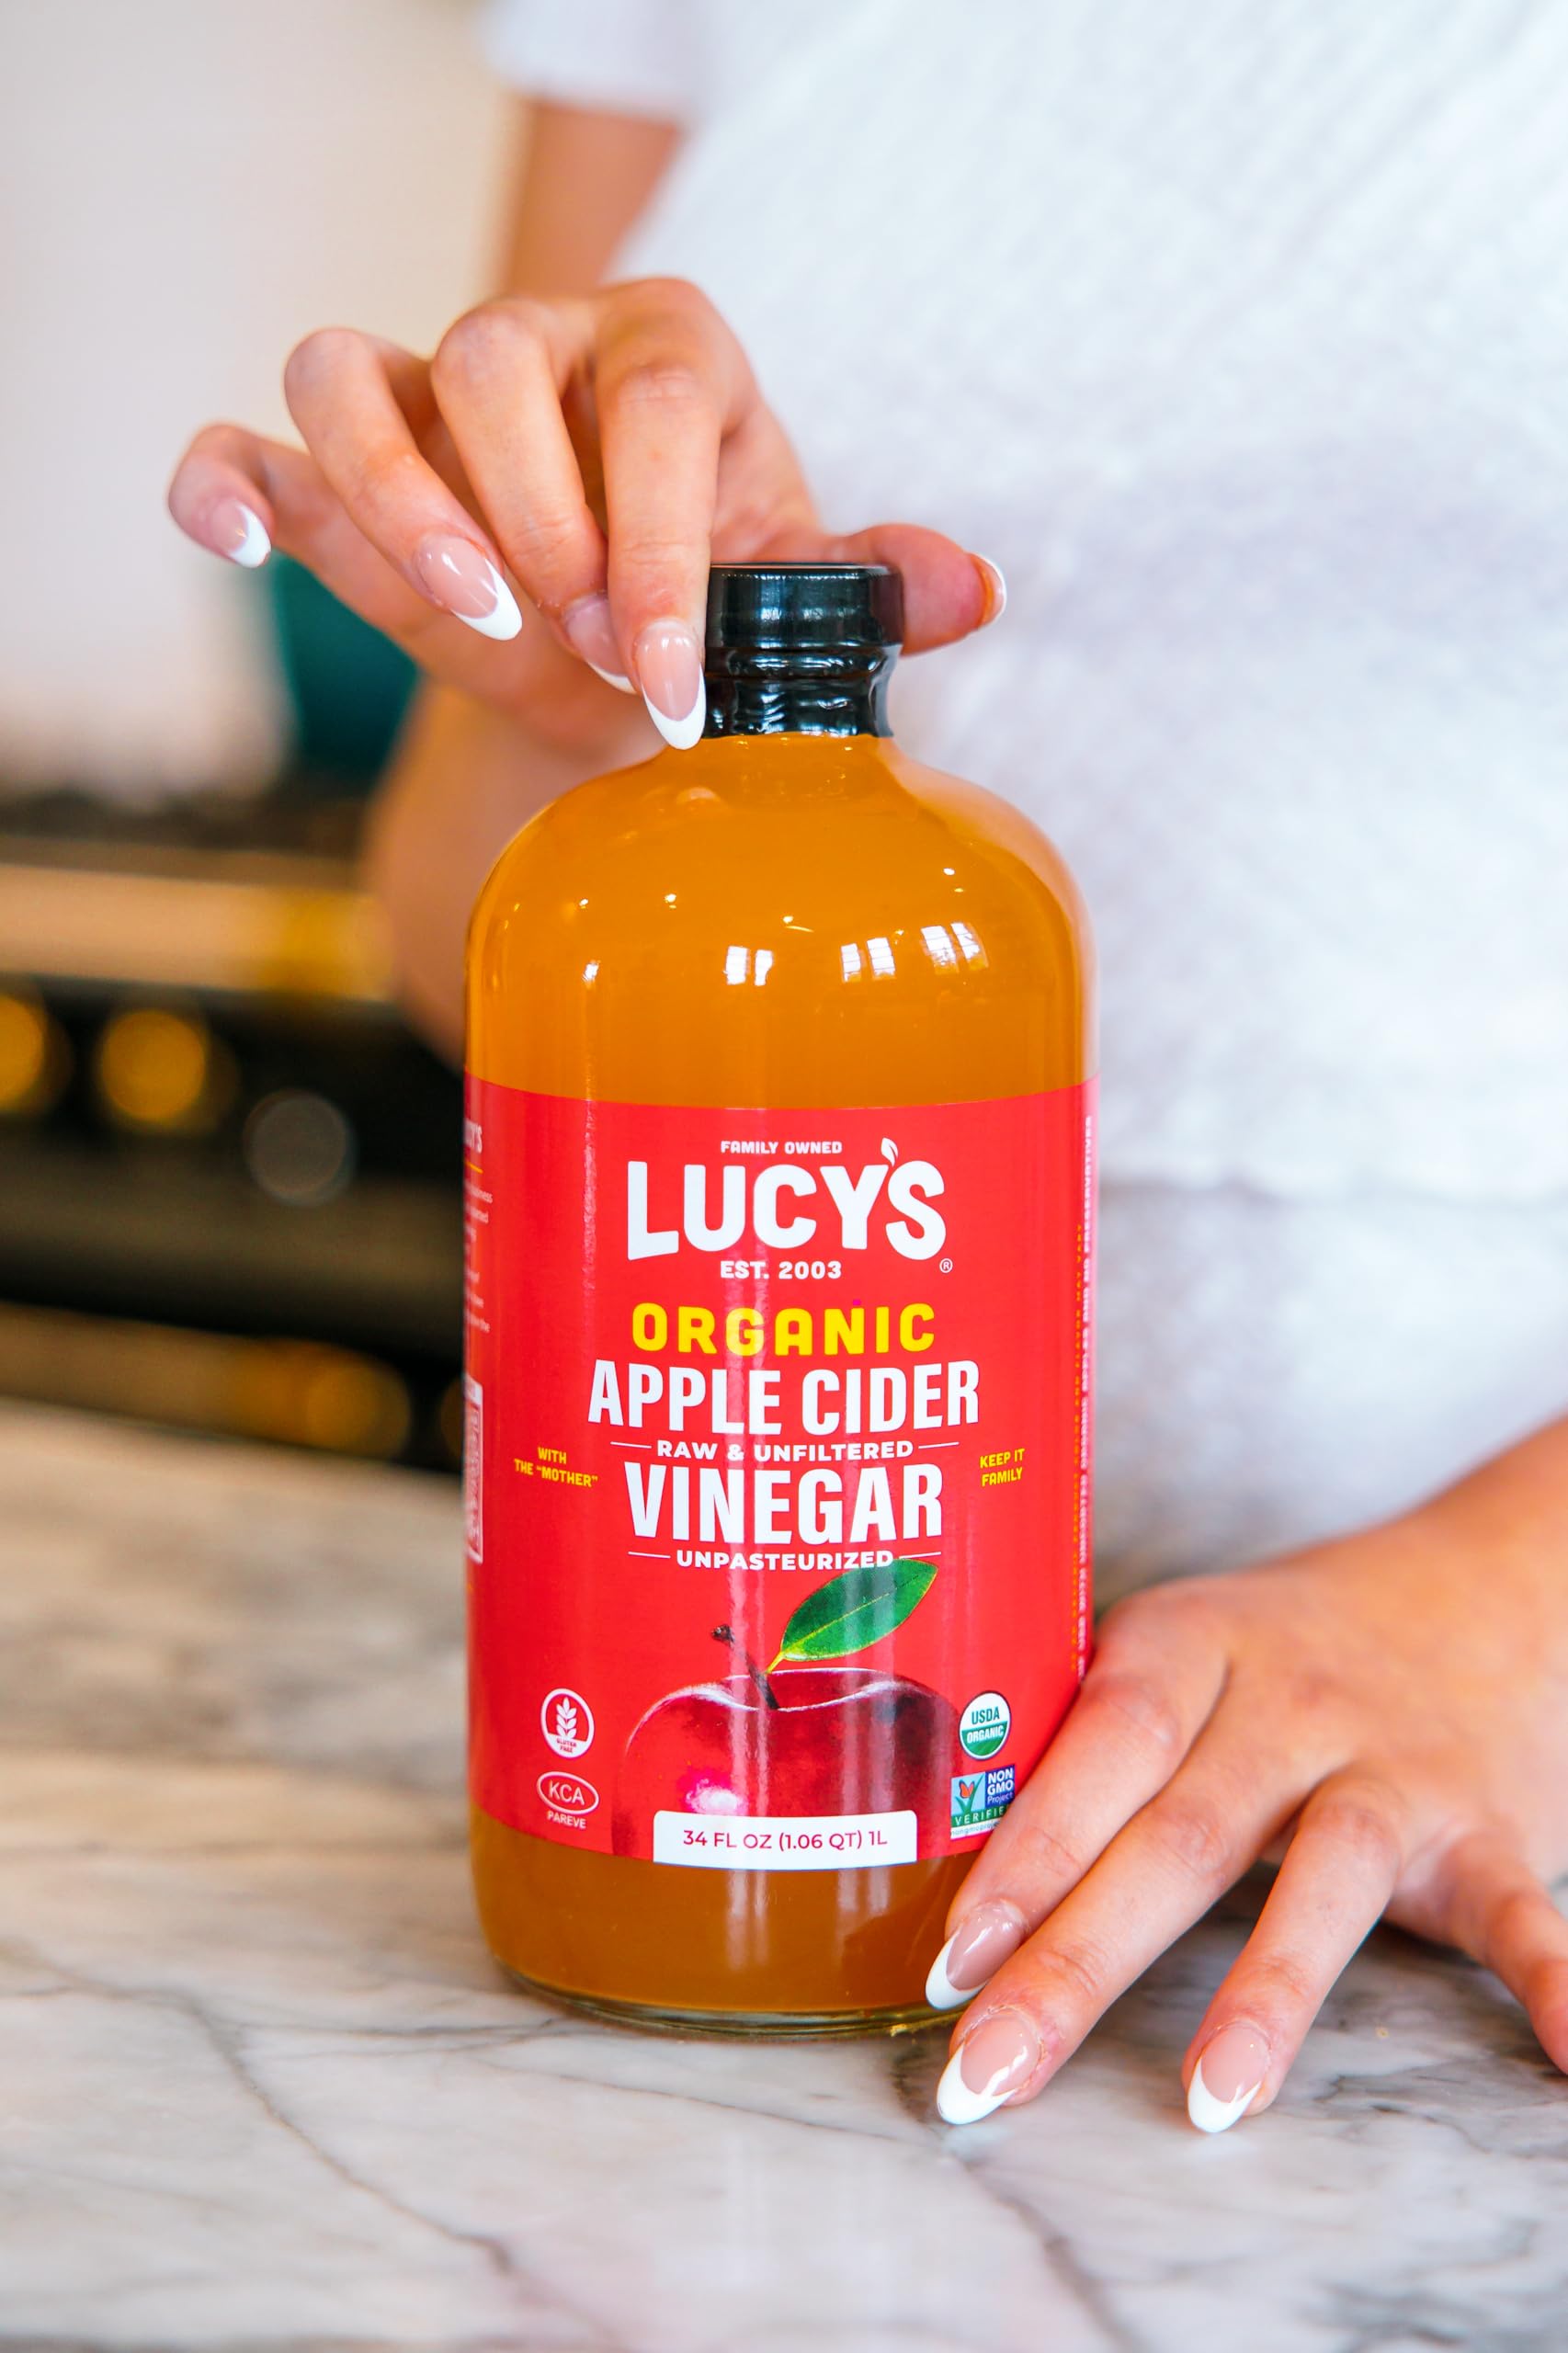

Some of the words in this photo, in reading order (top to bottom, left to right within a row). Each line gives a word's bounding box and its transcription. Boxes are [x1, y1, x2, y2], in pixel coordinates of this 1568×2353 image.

[721, 1141, 778, 1154] FAMILY
[784, 1141, 843, 1154] OWNED
[628, 1138, 946, 1260] LUCY'S
[720, 1261, 769, 1279] EST.
[778, 1260, 842, 1279] 2003
[632, 1302, 935, 1357] ORGANIC
[588, 1358, 782, 1435] APPLE
[801, 1359, 979, 1435] CIDER
[538, 1446, 567, 1464] WITH
[657, 1439, 718, 1461] RAW
[727, 1445, 744, 1461] &
[754, 1440, 914, 1462] UNFILTERED
[980, 1451, 1011, 1469] KEEP
[1014, 1448, 1026, 1462] IT
[514, 1459, 534, 1475] THE
[982, 1467, 1023, 1487] FAMILY
[624, 1461, 943, 1545] VINEGAR
[676, 1550, 893, 1572] UNPASTEURIZED
[971, 1706, 1001, 1725] USDA
[966, 1723, 1005, 1744] ORGANIC
[987, 1767, 1014, 1783] NON
[549, 1780, 585, 1806] KCA
[987, 1779, 1015, 1796] GMO
[987, 1791, 1015, 1805] Project
[547, 1810, 586, 1829] PAREVE
[954, 1805, 1006, 1826] VERIFIE
[683, 1830, 708, 1847] 34
[713, 1832, 736, 1848] FL
[744, 1834, 772, 1849] OZ
[778, 1832, 824, 1852] (1.06
[828, 1831, 862, 1850] QT)
[869, 1830, 888, 1846] 1L
